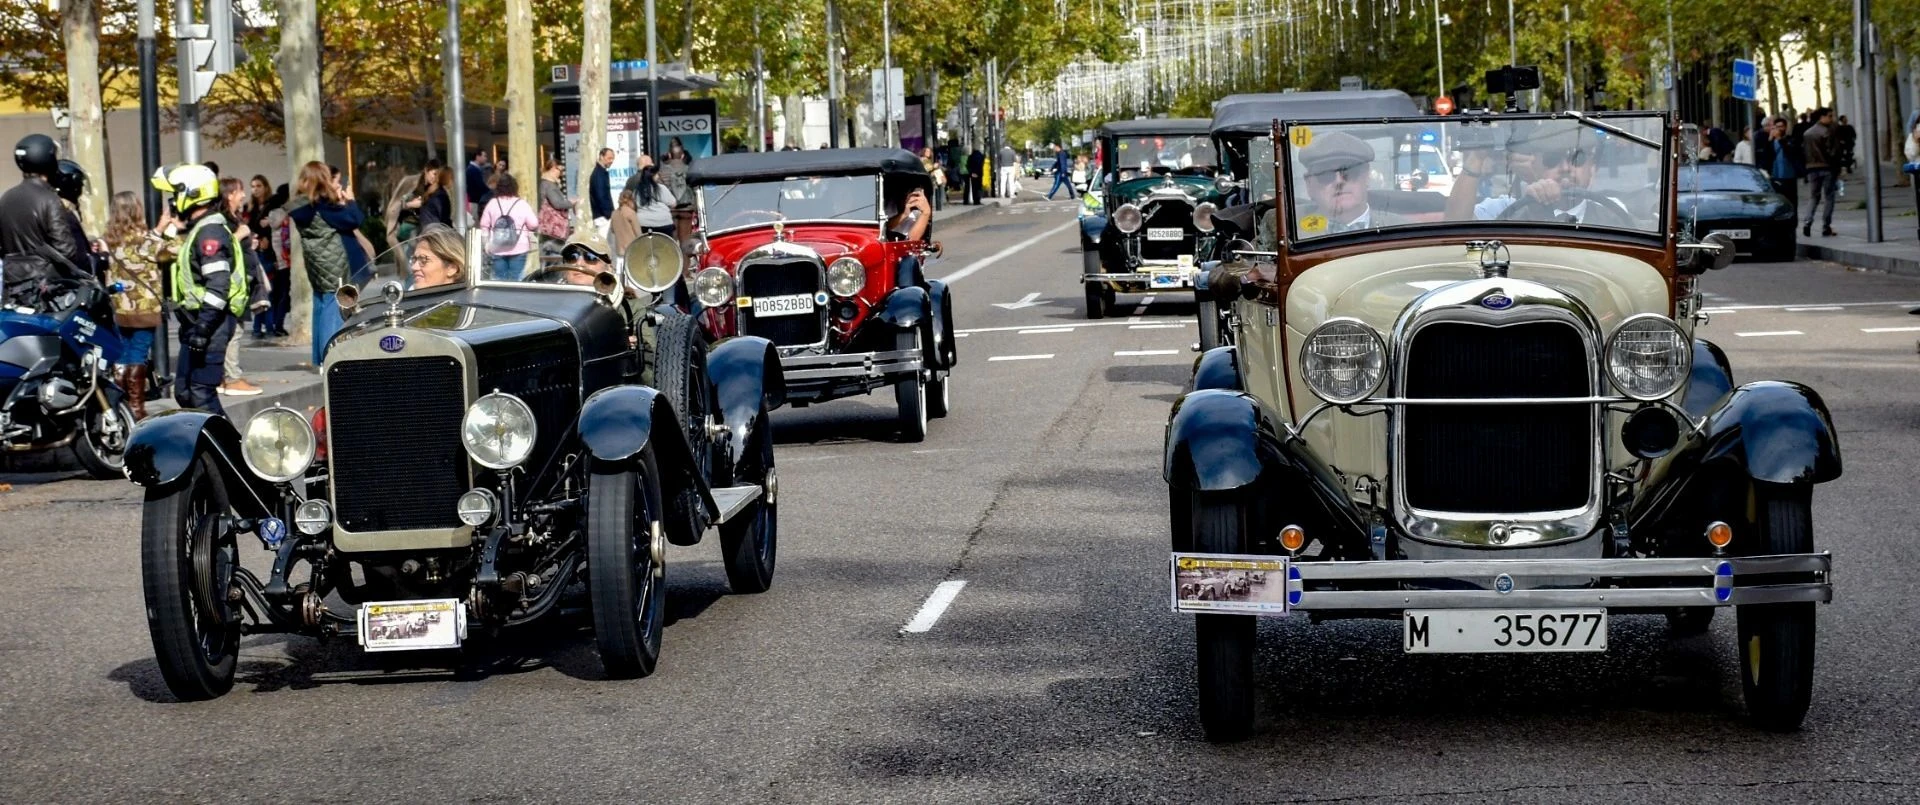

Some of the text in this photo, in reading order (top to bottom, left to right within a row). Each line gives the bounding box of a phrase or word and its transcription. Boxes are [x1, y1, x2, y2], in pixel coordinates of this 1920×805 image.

[657, 118, 709, 132] ANGO
[1296, 128, 1306, 145] H
[754, 297, 813, 313] H0852BBD
[1486, 296, 1509, 305] Ford
[1409, 614, 1602, 647] M 35677
